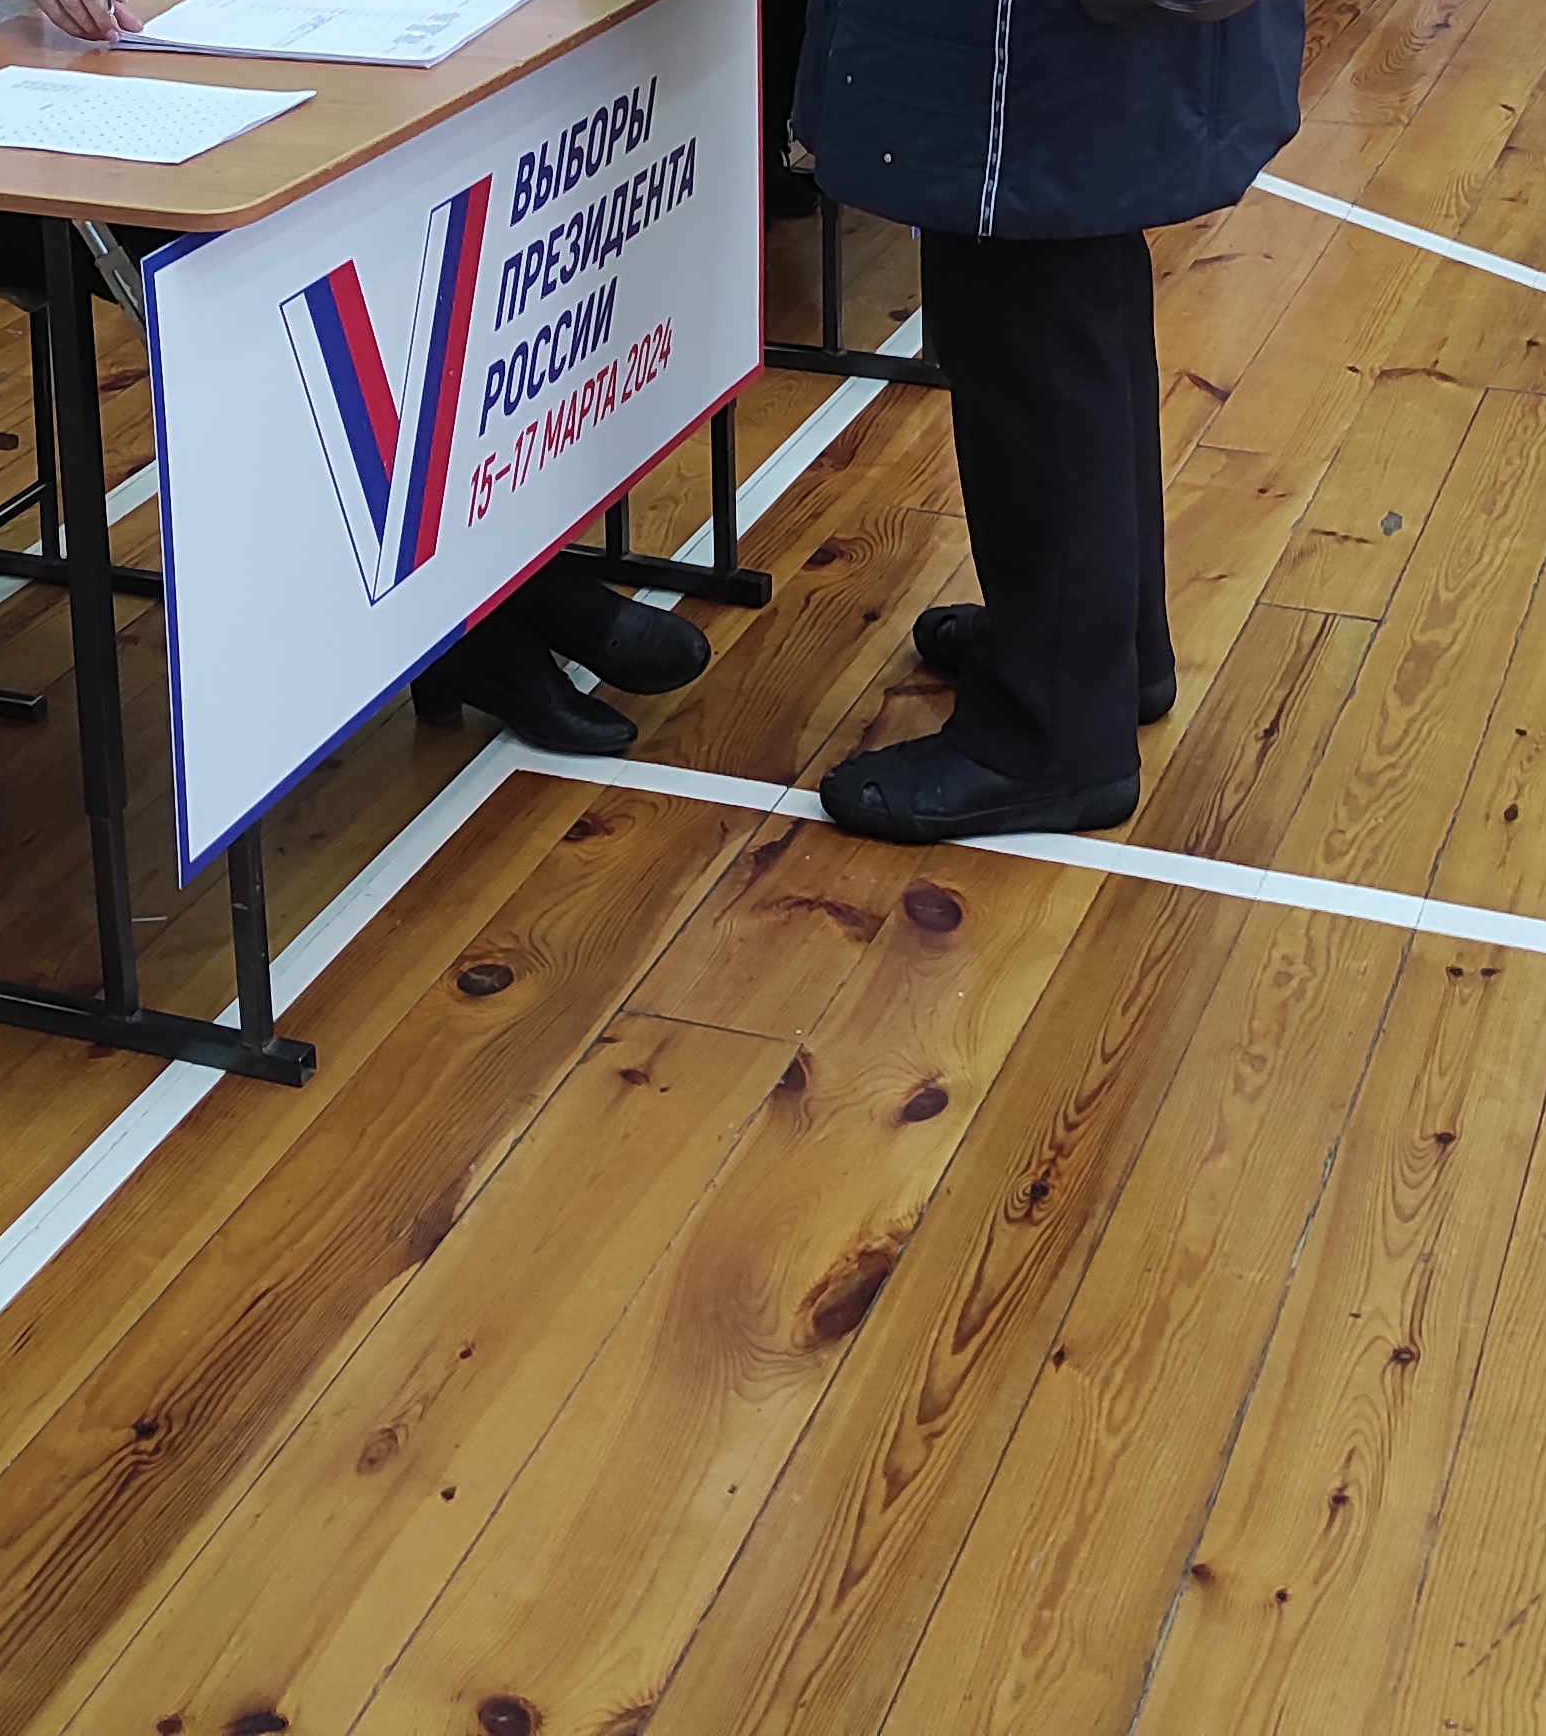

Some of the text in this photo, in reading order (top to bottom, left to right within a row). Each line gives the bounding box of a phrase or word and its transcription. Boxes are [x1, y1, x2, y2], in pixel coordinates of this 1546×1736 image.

[509, 75, 659, 228] ВЫБОРЫ
[494, 136, 698, 332] ПРЕЗИДЕНТА
[478, 274, 620, 439] РОССИИ
[539, 358, 618, 472] МАРТА
[620, 316, 673, 406] 2024
